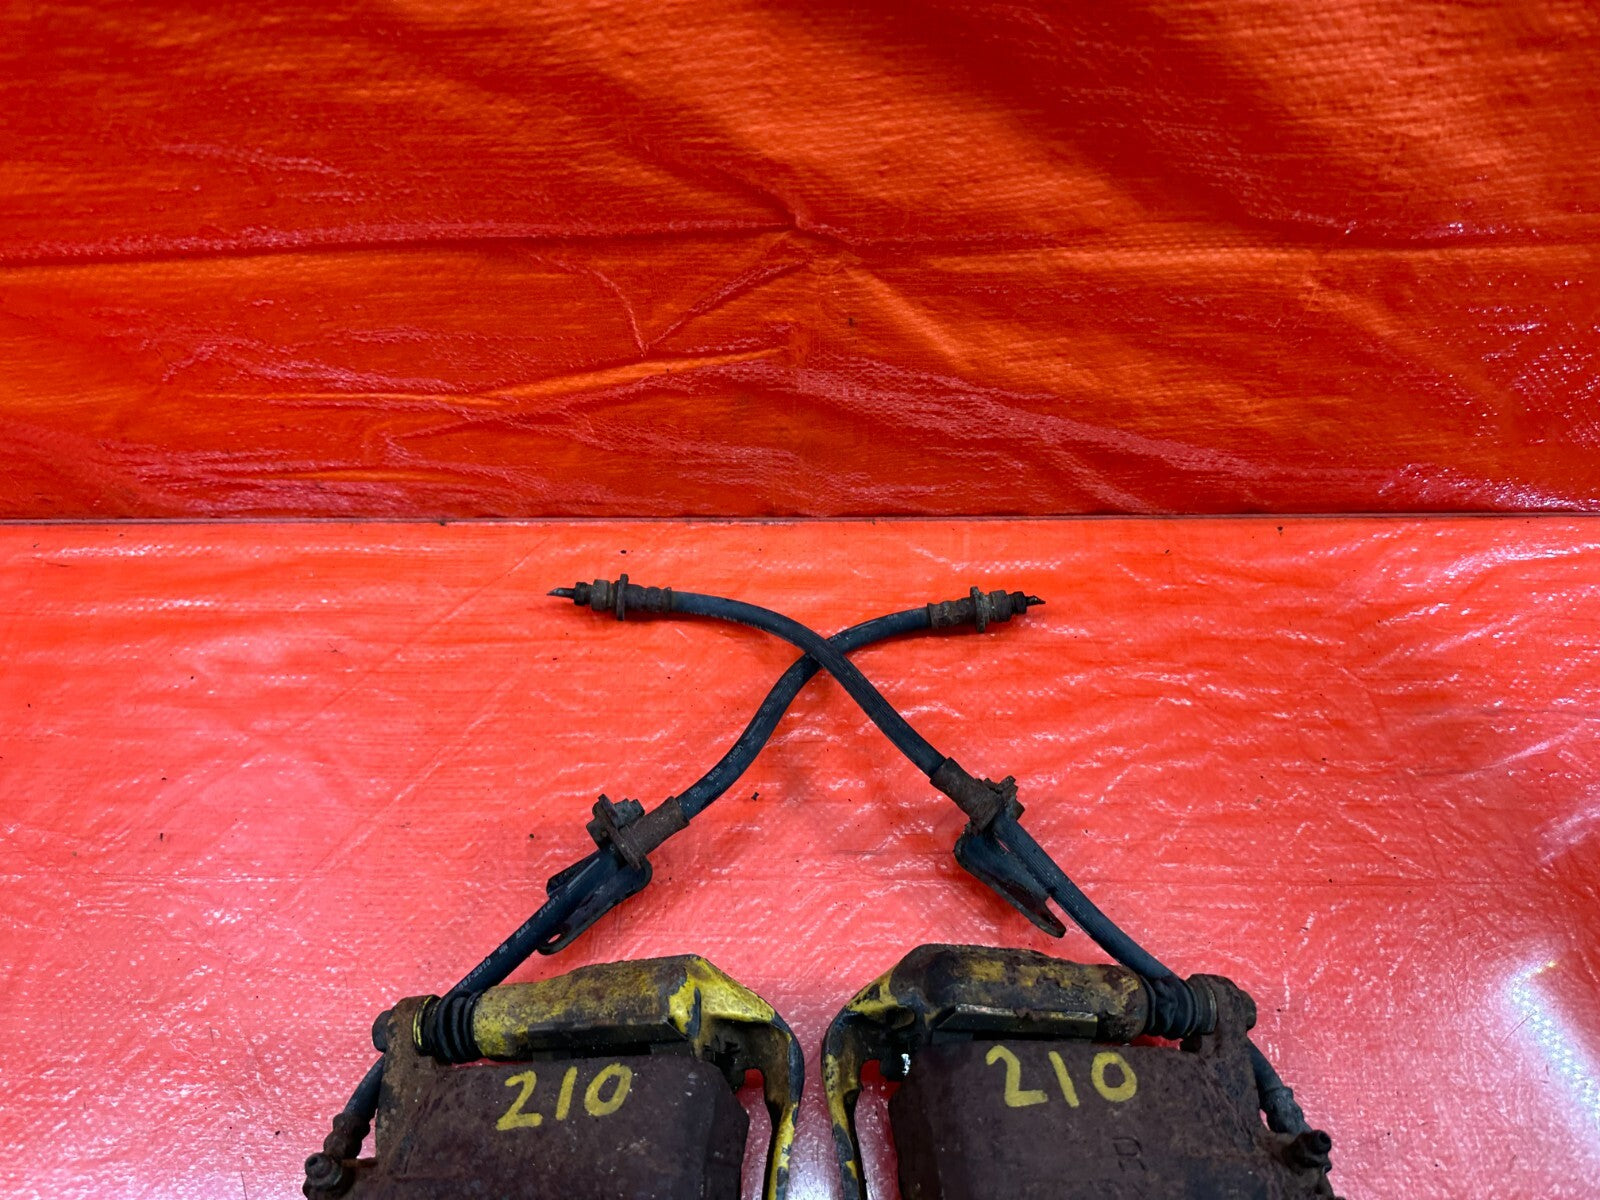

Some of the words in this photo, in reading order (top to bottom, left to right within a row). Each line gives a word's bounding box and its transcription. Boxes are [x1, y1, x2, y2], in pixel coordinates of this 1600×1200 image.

[495, 1062, 633, 1132] 210
[985, 1045, 1138, 1108] 210
[1112, 1136, 1148, 1172] R
